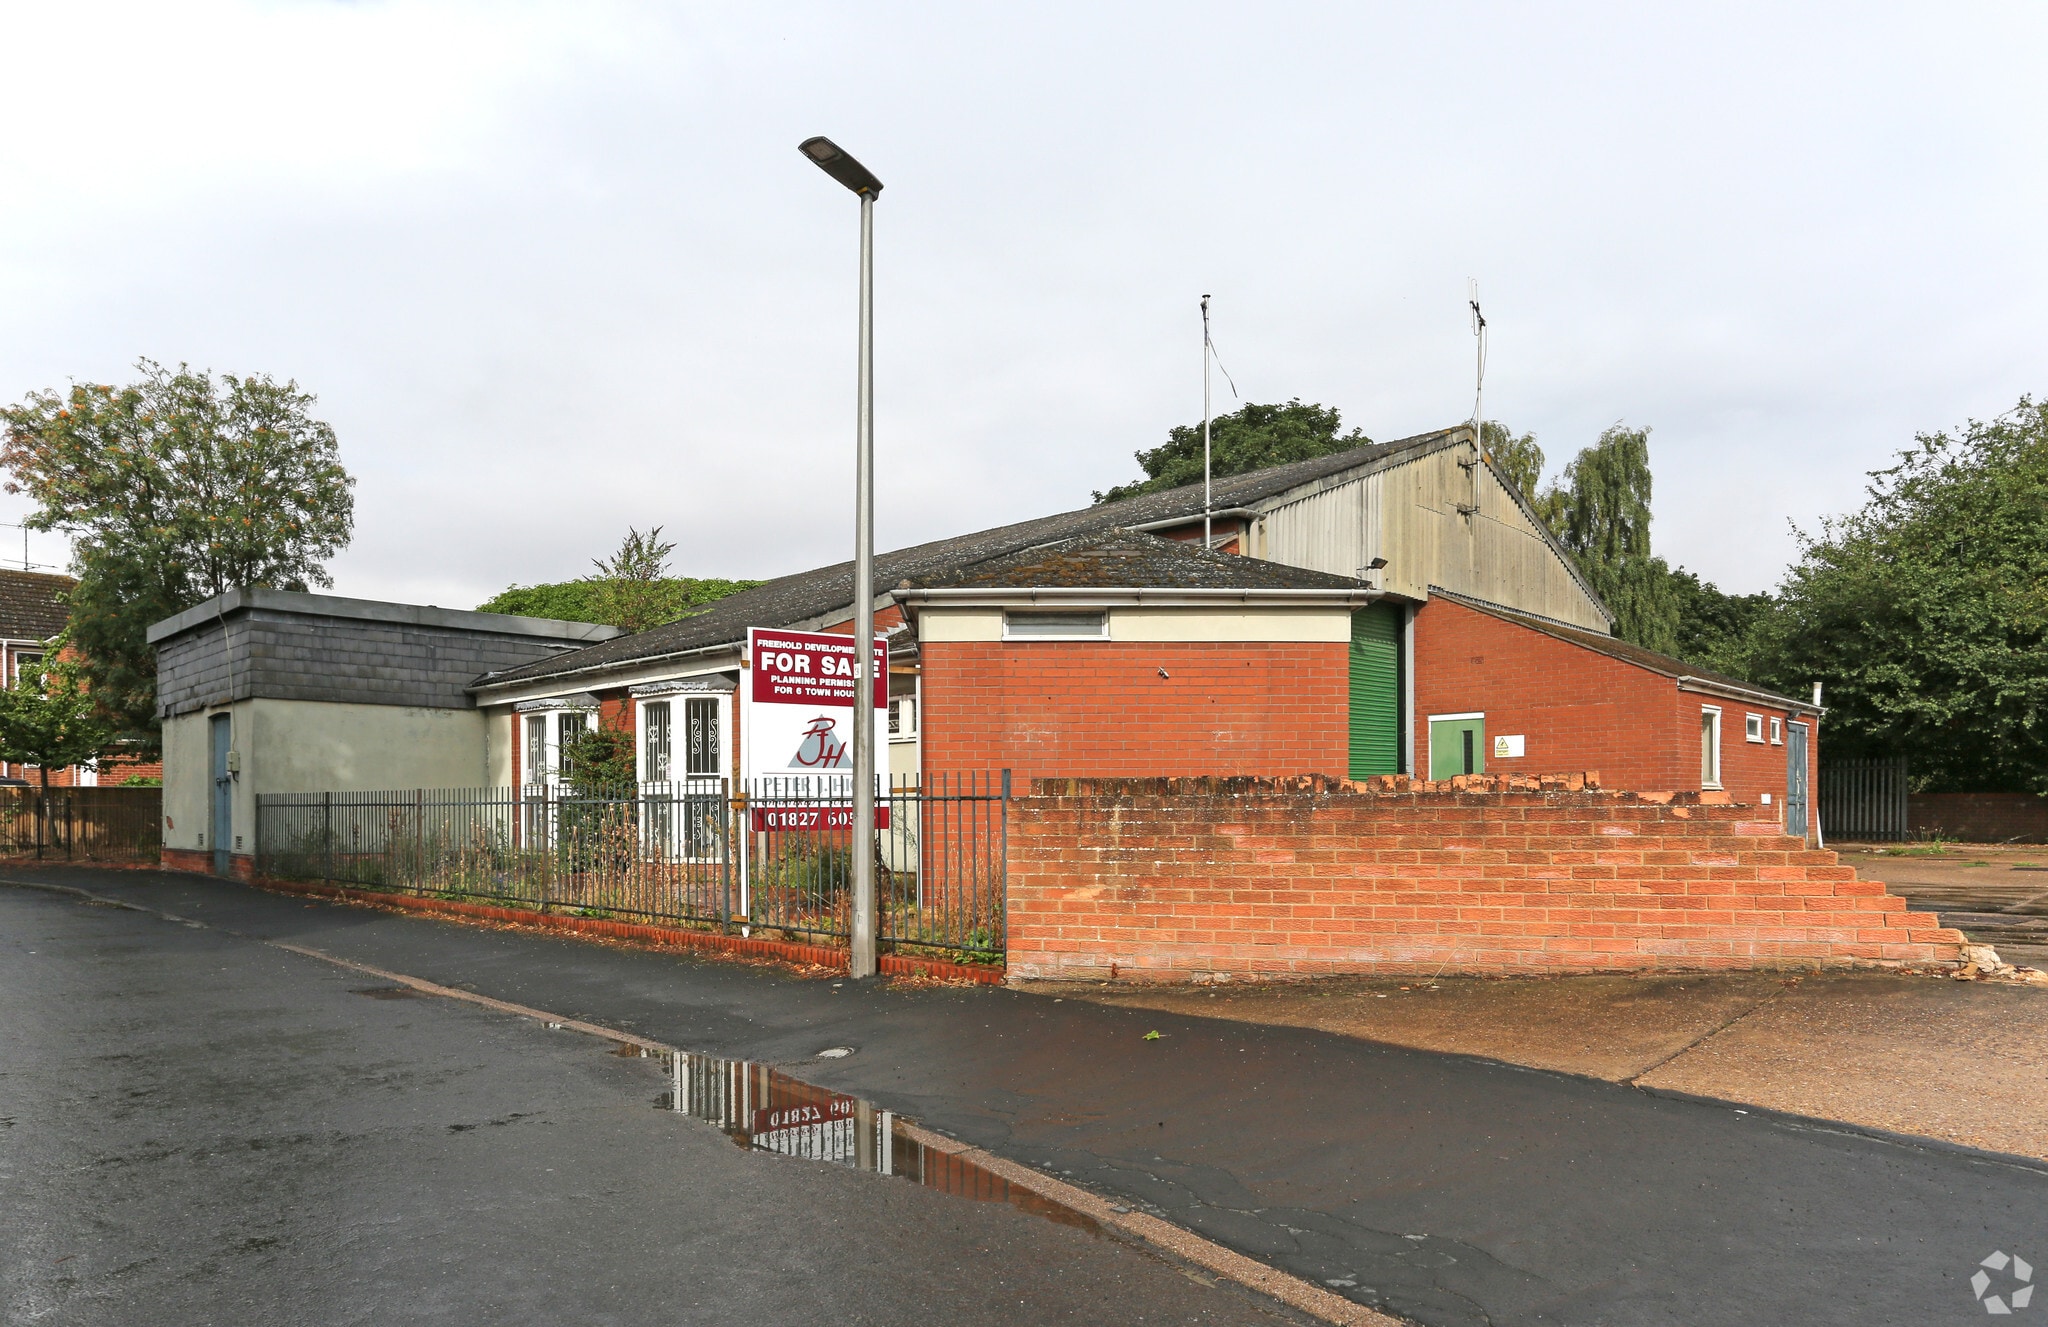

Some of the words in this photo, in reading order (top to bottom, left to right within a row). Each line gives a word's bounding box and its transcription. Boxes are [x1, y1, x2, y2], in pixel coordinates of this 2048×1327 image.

[757, 639, 802, 650] FREEHOLD
[805, 642, 855, 654] DEVELOPME
[761, 651, 811, 674] FOR
[821, 655, 881, 679] SAE
[771, 675, 817, 686] PLANNING
[819, 678, 855, 688] PERMISS
[775, 686, 793, 695] FOR
[796, 687, 802, 695] 6
[805, 687, 831, 697] TOWN
[834, 689, 855, 698] HOUS
[763, 777, 811, 792] PETER
[767, 811, 819, 826] 01827
